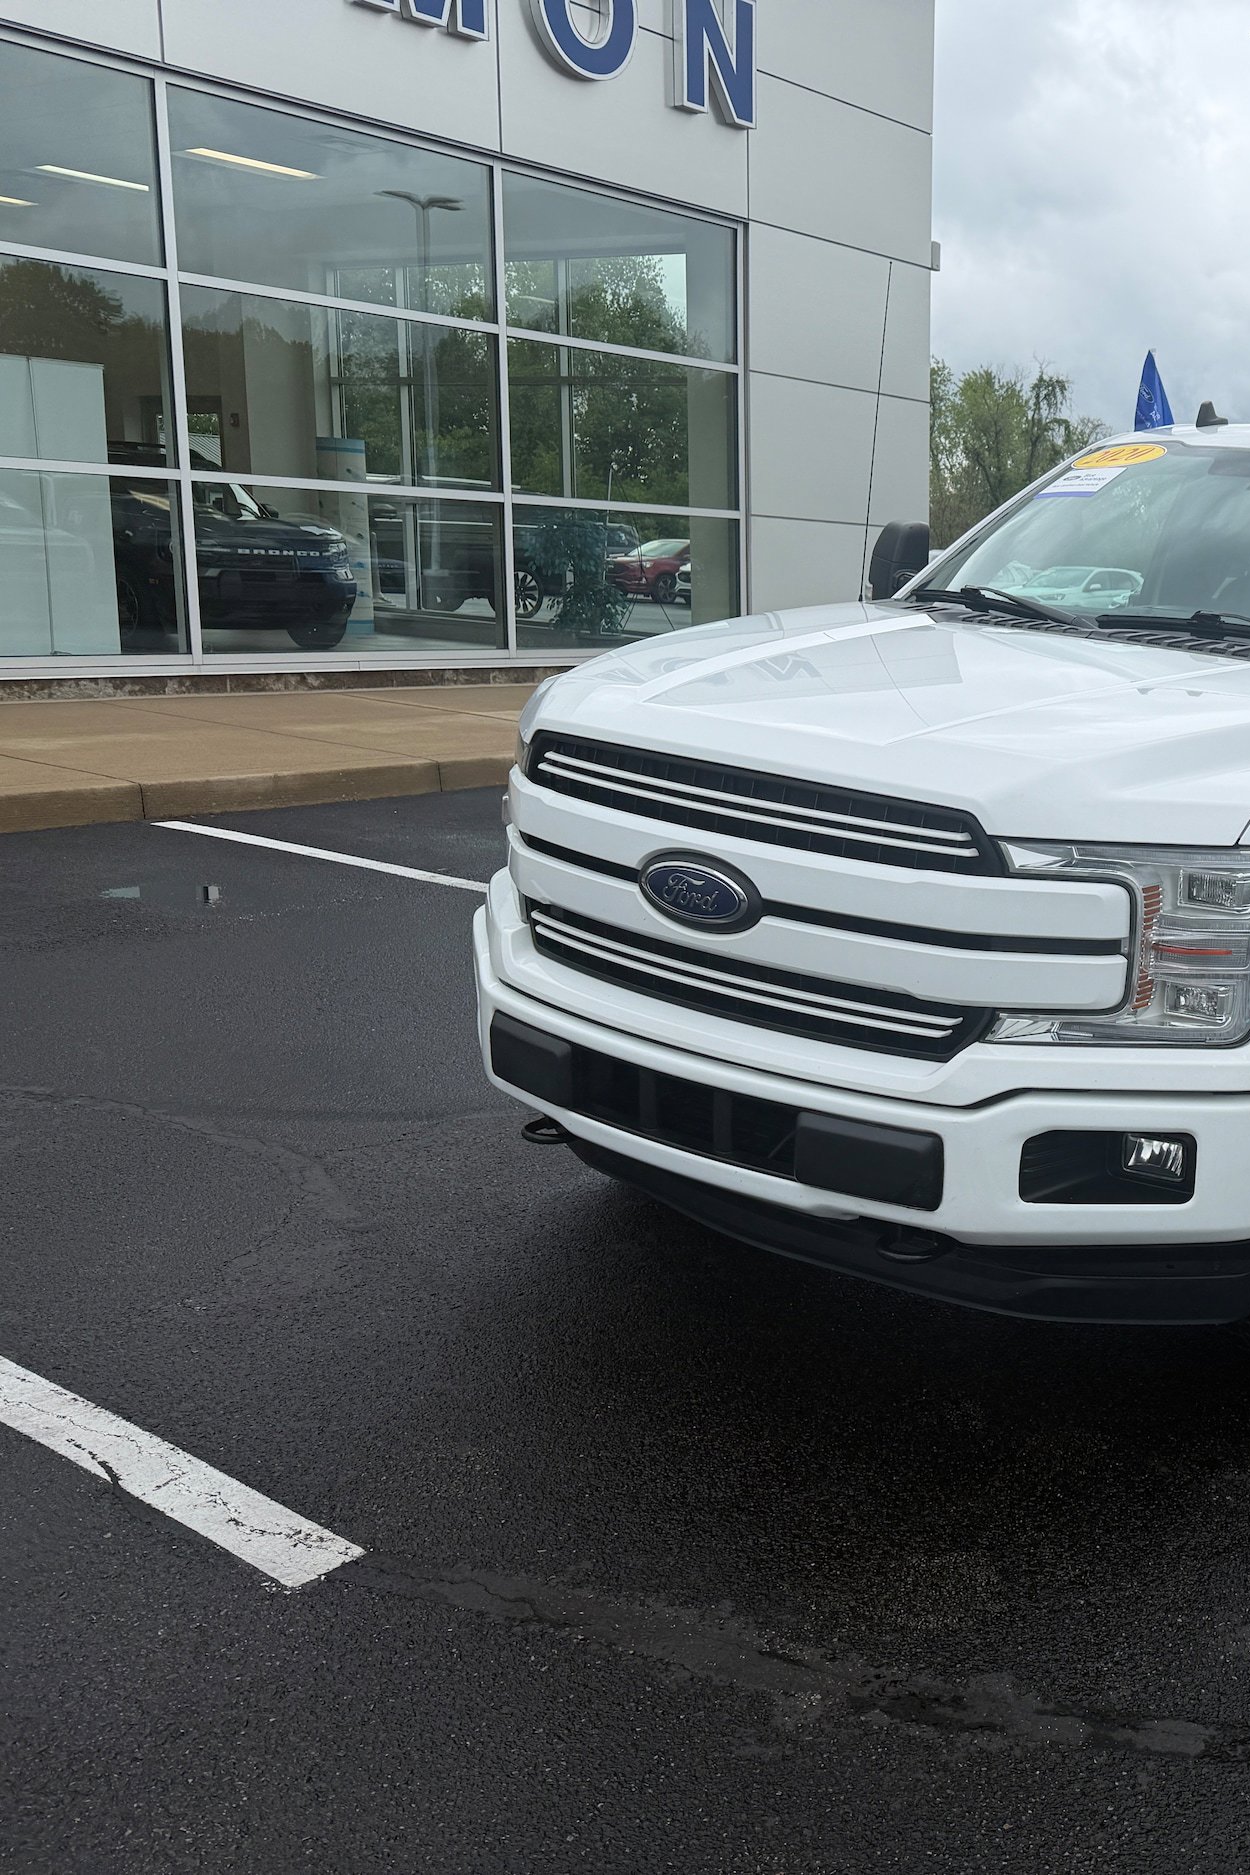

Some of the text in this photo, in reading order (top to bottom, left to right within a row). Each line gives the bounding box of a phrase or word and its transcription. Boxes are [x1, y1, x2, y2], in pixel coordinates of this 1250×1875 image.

[347, 0, 757, 129] ON
[237, 547, 321, 557] BRONCO
[662, 872, 720, 912] Ford
